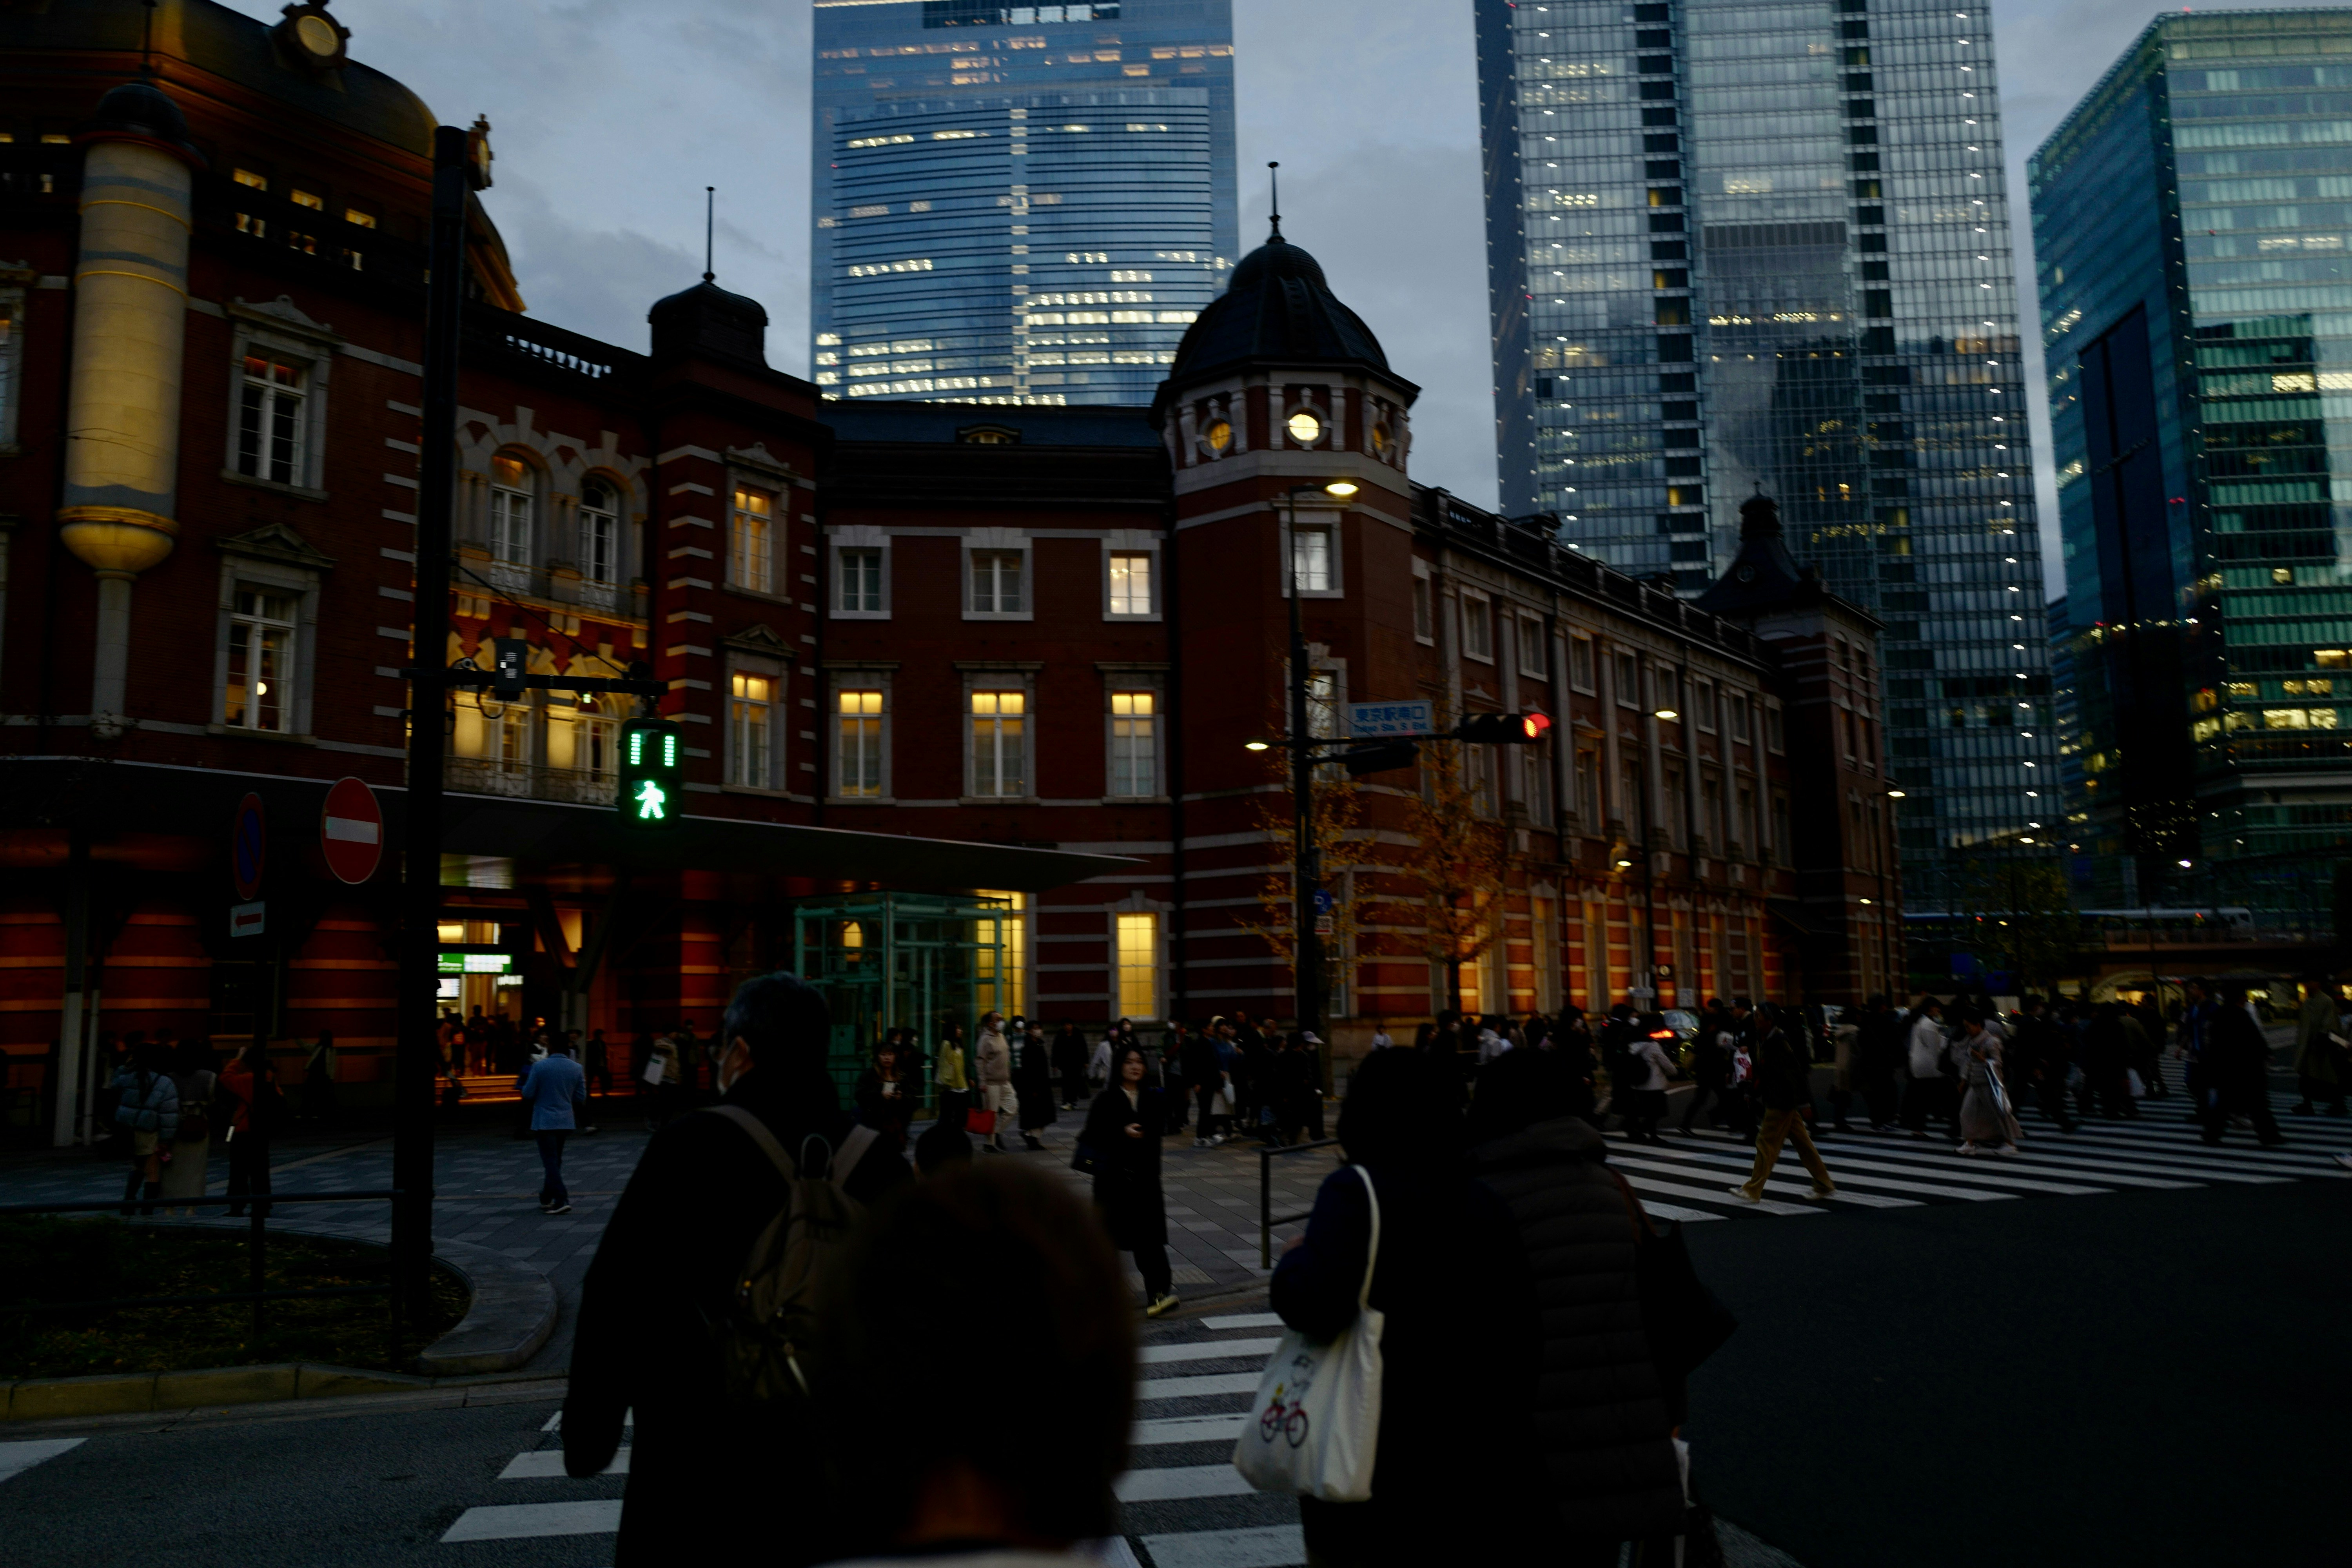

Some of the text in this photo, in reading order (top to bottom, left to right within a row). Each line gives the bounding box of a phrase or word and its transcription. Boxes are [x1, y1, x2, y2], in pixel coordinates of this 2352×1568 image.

[1355, 706, 1424, 722] 東京駅南口
